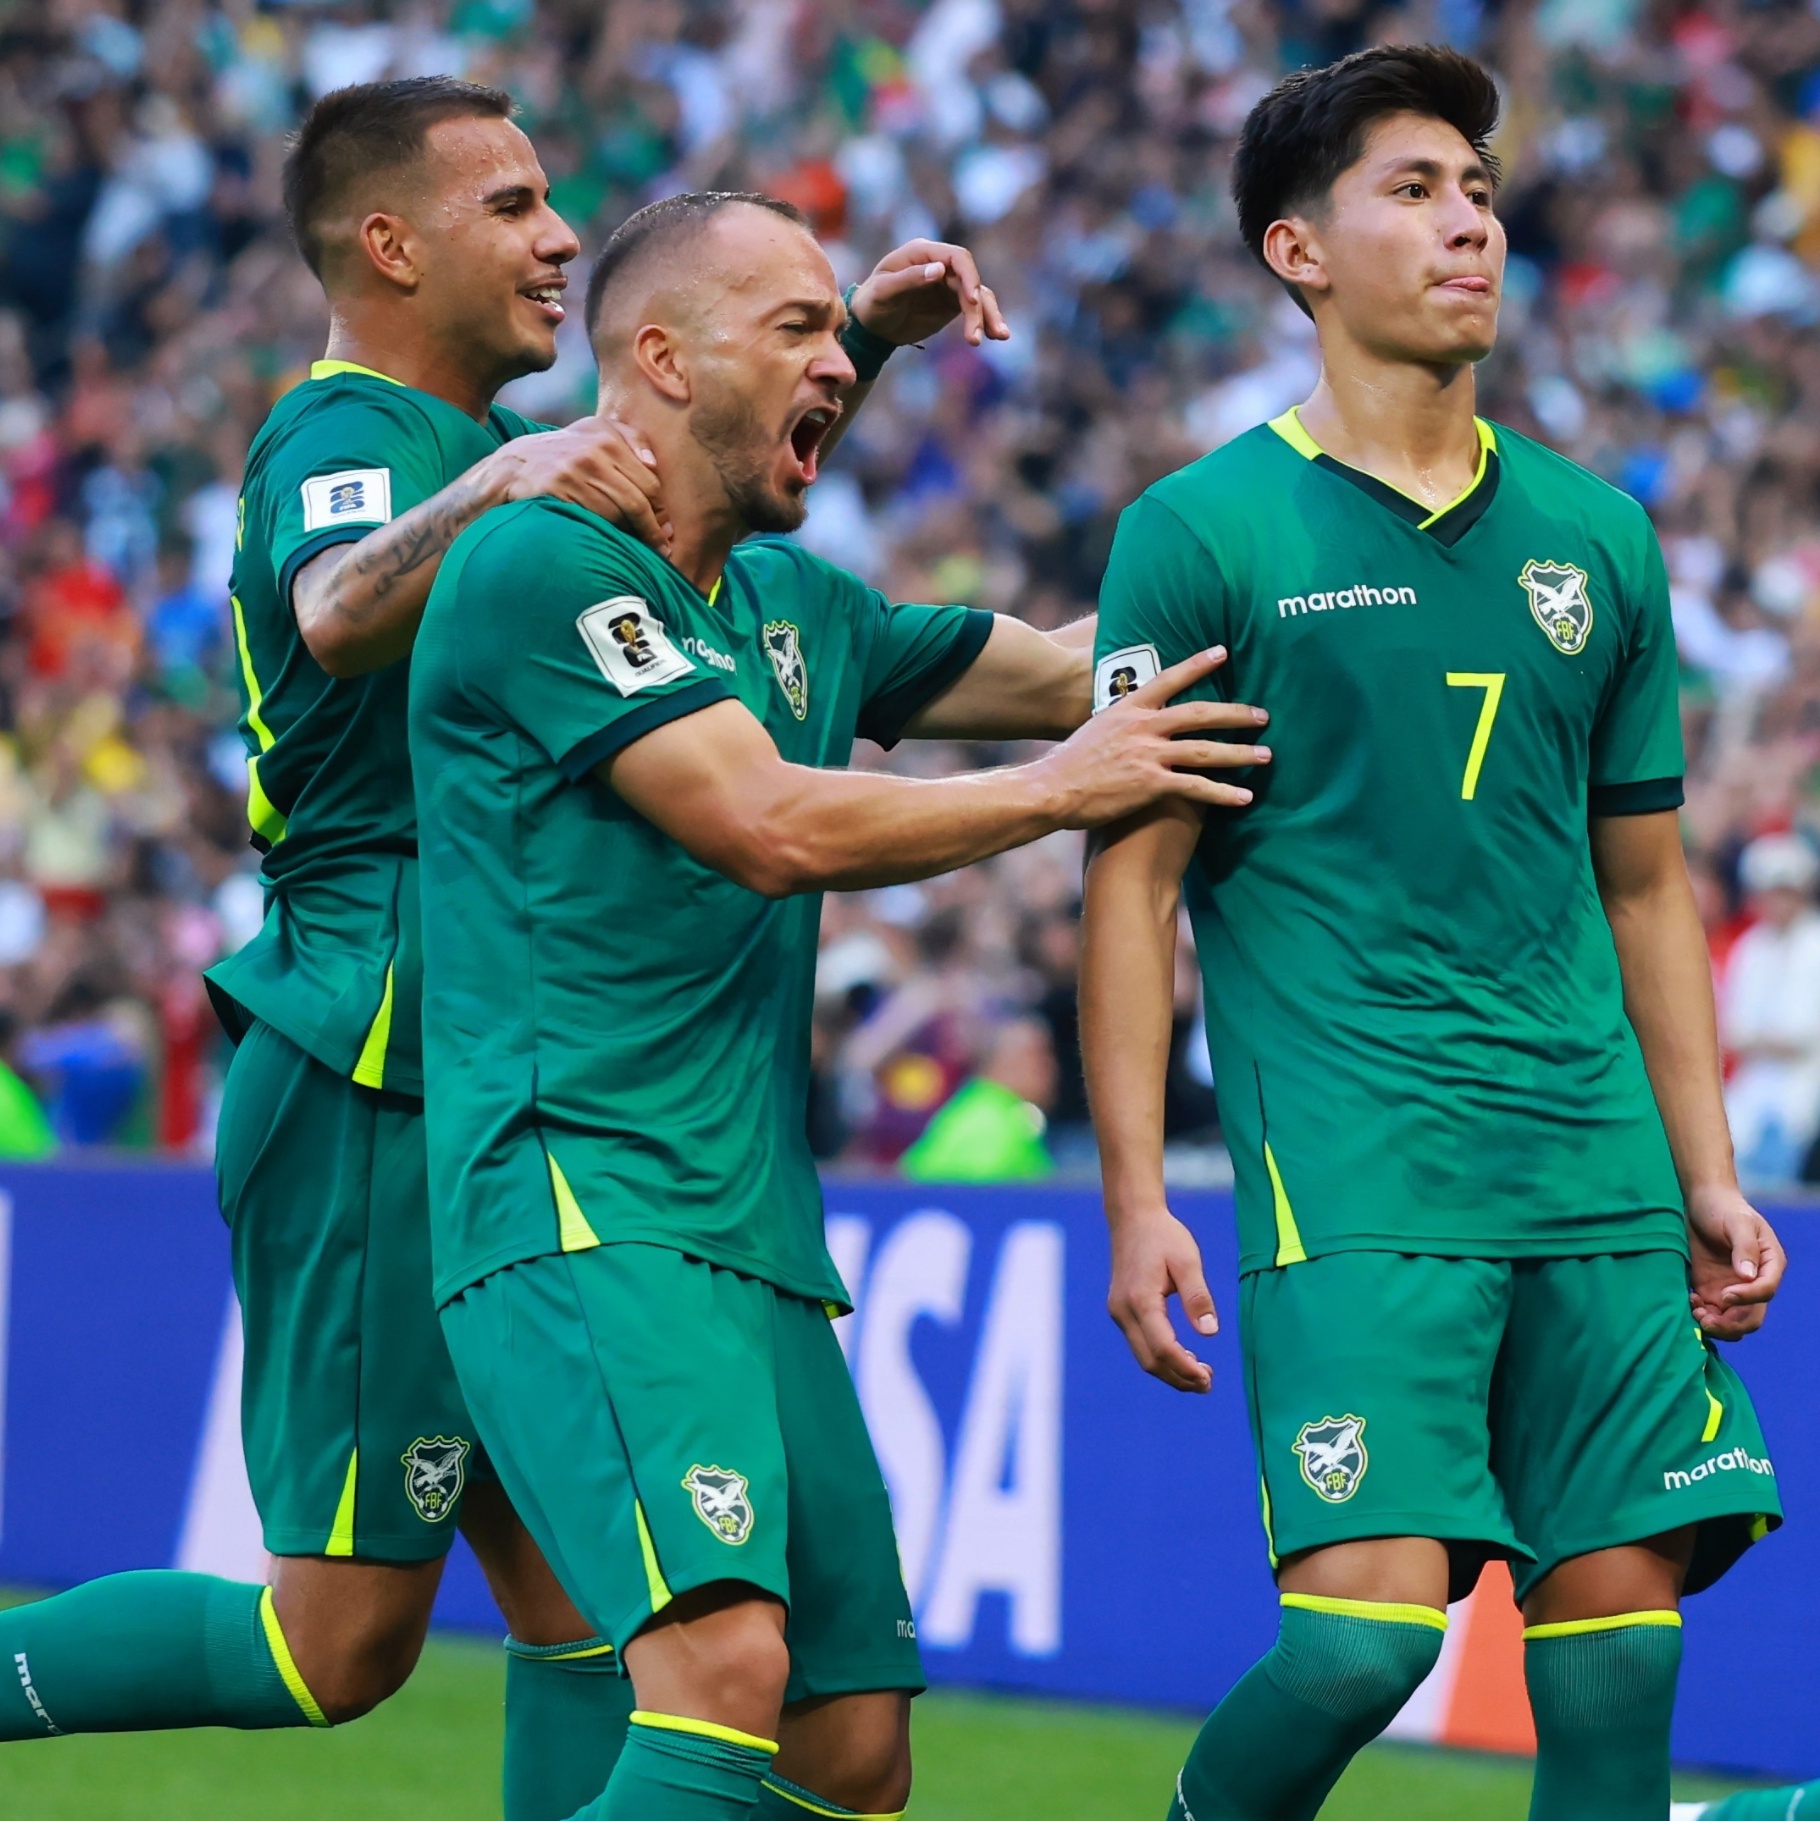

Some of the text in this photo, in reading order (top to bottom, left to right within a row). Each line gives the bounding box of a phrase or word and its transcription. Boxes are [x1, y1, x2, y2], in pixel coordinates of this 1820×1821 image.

[1277, 584, 1417, 618] marathon
[1556, 620, 1575, 640] FBF
[1445, 672, 1506, 801] 7
[1326, 1472, 1347, 1491] FBF
[1663, 1447, 1775, 1490] marathon
[425, 1492, 442, 1509] FBF
